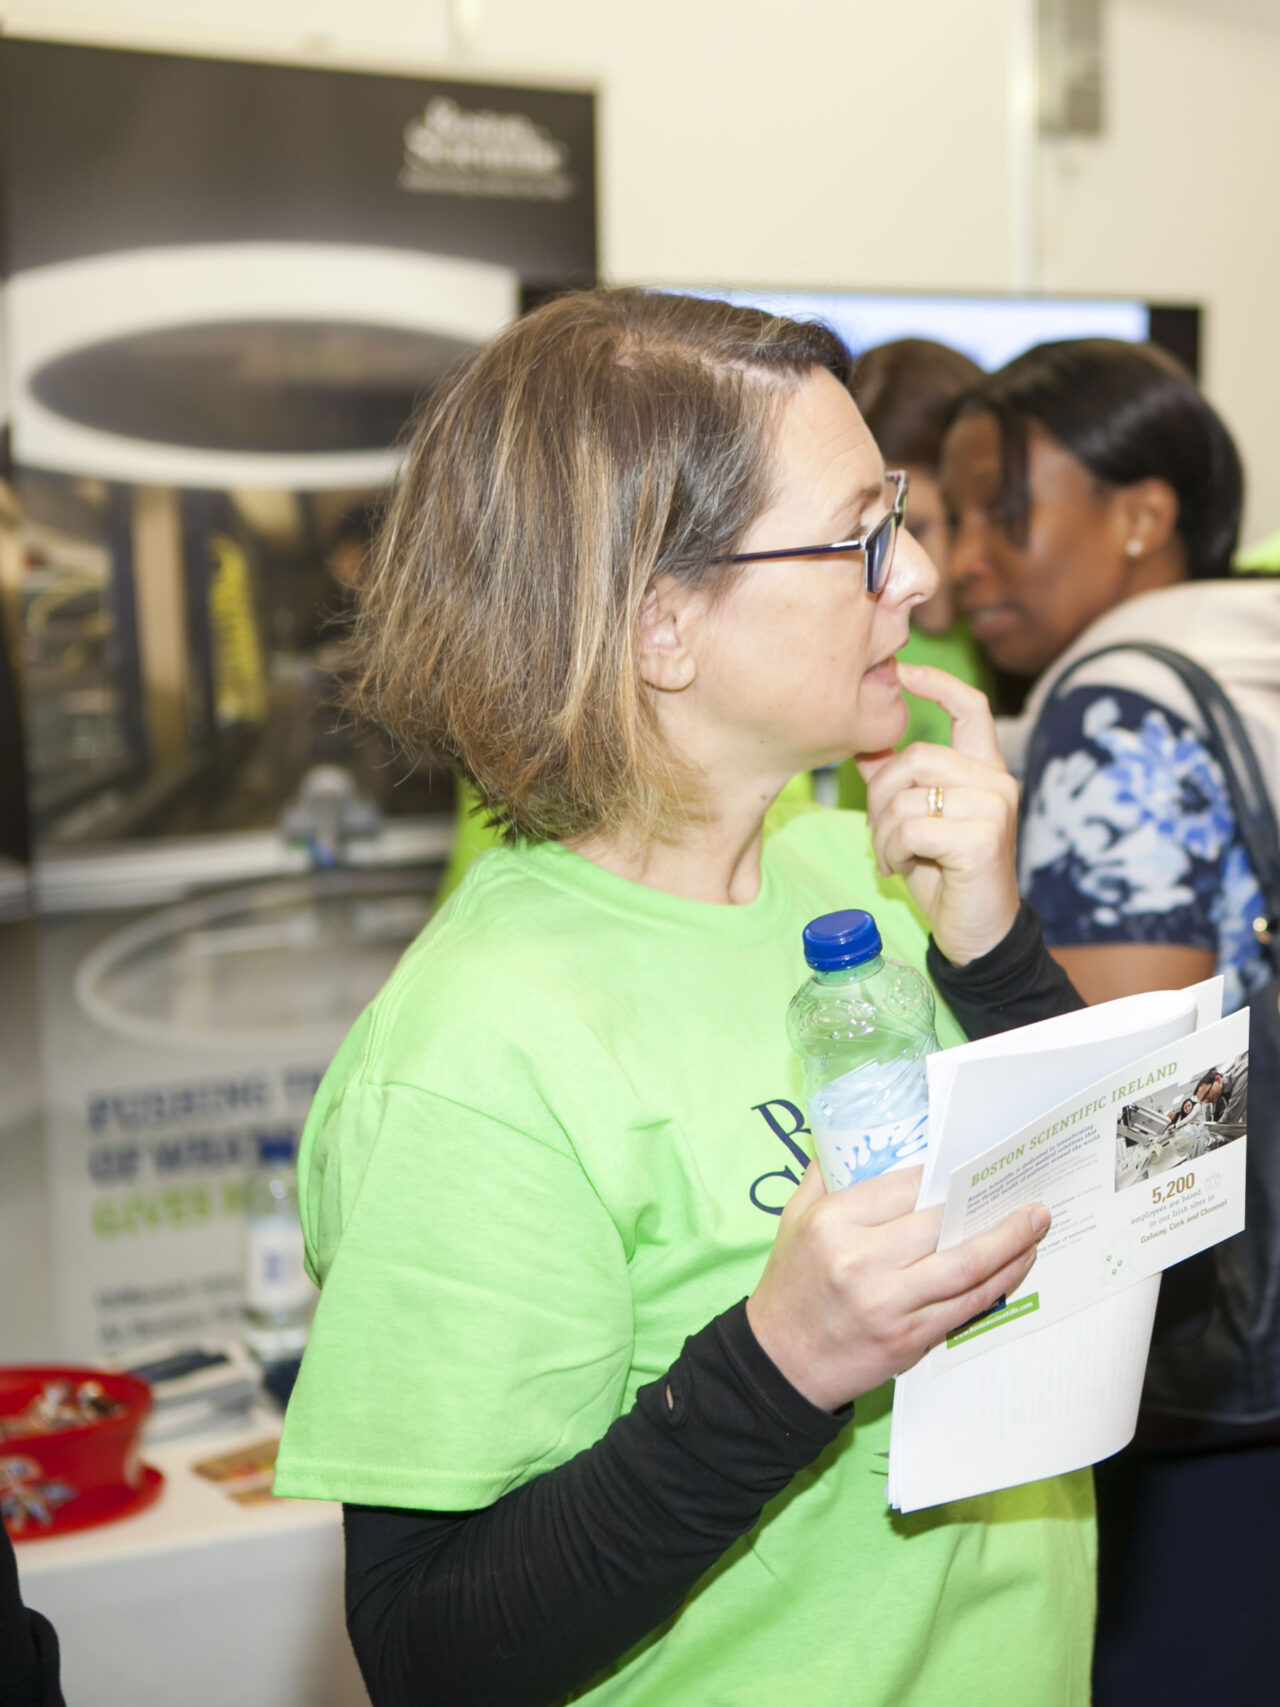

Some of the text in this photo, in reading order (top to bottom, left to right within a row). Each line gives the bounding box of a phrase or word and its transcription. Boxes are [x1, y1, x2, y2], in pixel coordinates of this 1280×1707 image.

[970, 1062, 1178, 1187] BOSTON SCIENTIFIC IRELAND
[1152, 1172, 1195, 1204] 5,200
[1131, 1189, 1201, 1225] employees are based
[1149, 1194, 1215, 1228] in our Irish sites in
[1169, 1219, 1185, 1231] Cork
[1186, 1211, 1199, 1223] and
[1200, 1198, 1228, 1217] Clonmel
